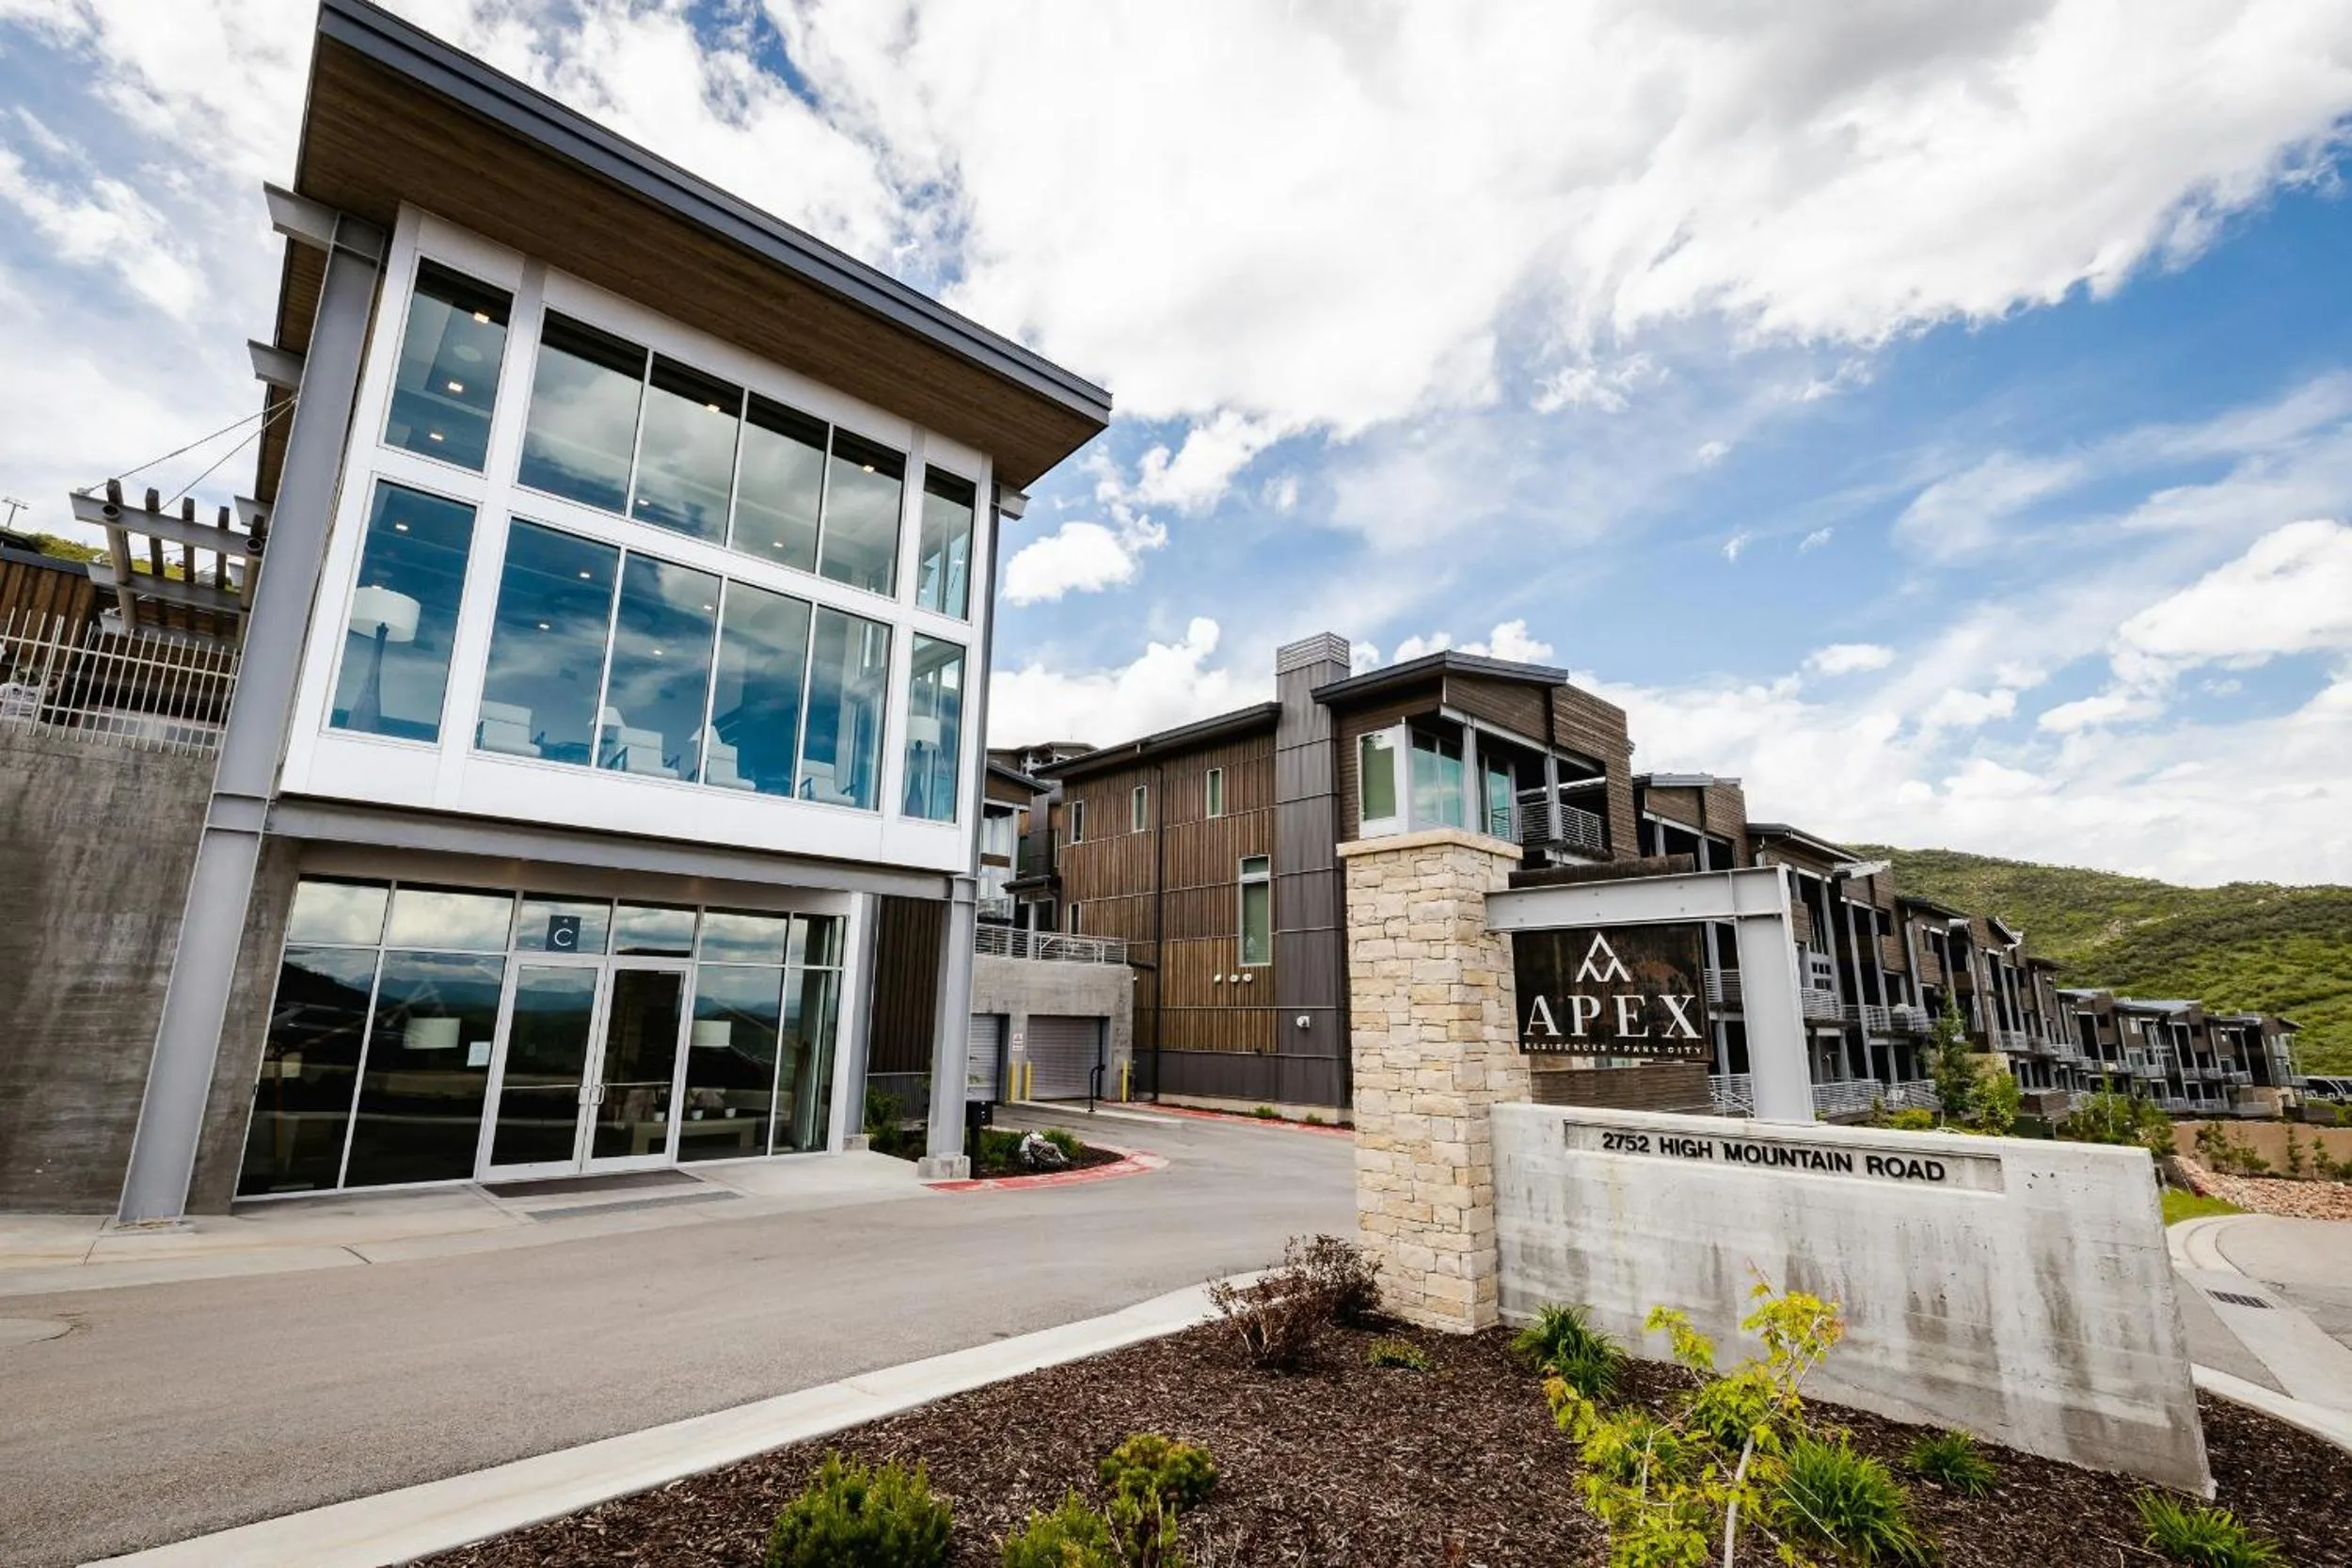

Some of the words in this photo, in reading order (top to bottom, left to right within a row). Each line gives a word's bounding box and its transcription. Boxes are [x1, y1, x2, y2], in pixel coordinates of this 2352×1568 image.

[554, 927, 573, 946] C
[1523, 994, 1702, 1039] APEX
[1623, 1045, 1660, 1053] PARK
[1667, 1046, 1702, 1054] CITY
[1602, 1132, 1650, 1153] 2752
[1659, 1136, 1713, 1159] HIGH
[1722, 1141, 1853, 1173] MOUNTAIN
[1866, 1155, 1946, 1181] ROAD
